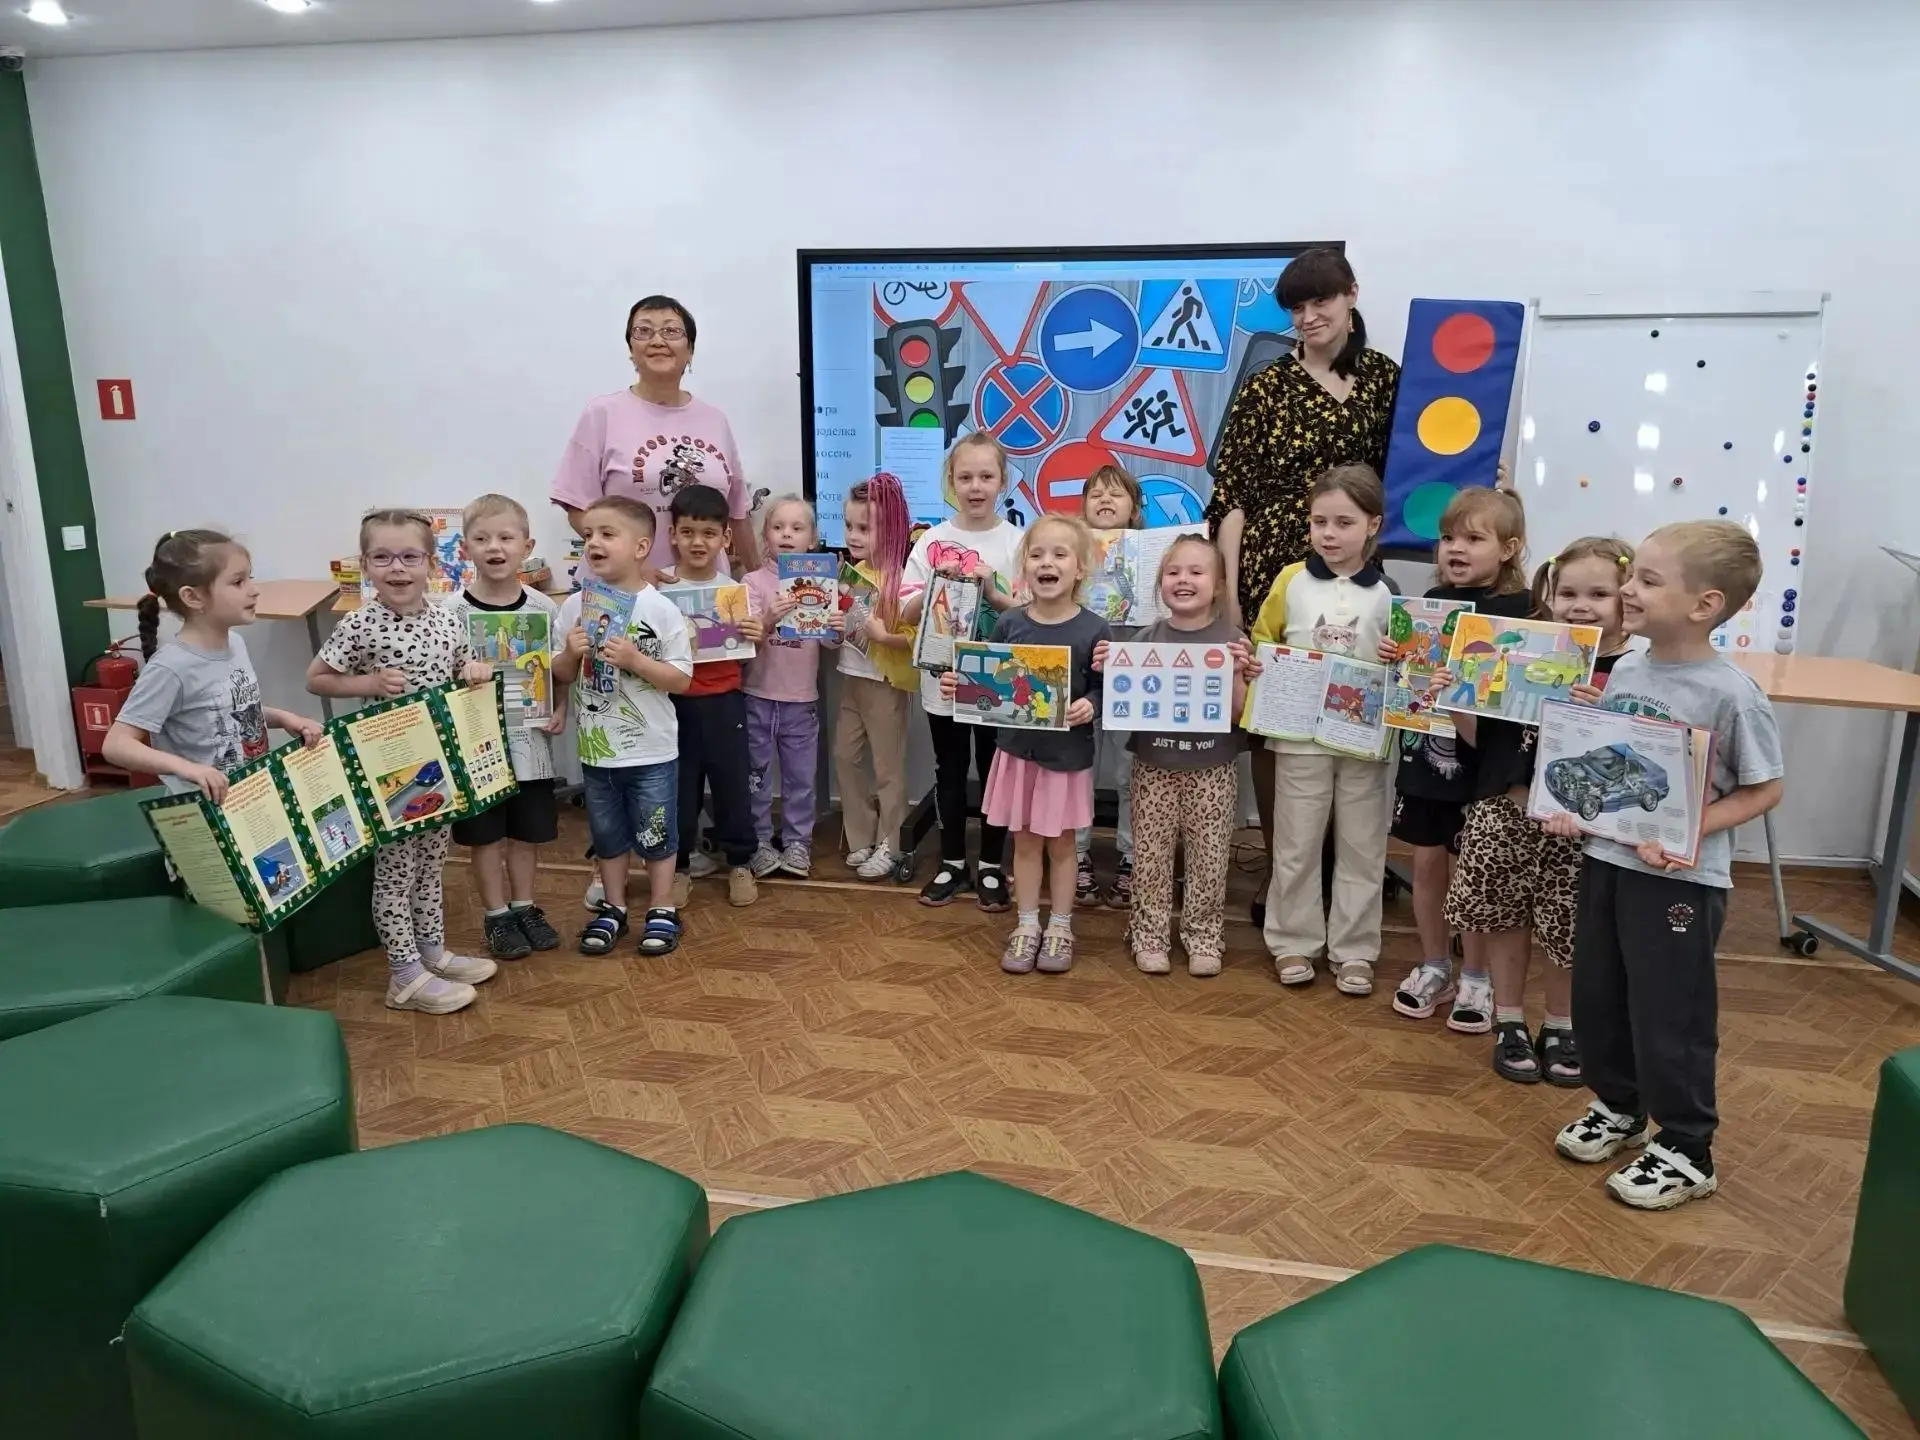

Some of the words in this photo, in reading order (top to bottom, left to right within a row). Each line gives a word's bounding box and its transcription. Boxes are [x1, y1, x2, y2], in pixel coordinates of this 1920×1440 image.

[632, 435, 668, 483] MOTOS
[1207, 704, 1217, 718] P
[1152, 737, 1176, 749] JUST
[1179, 740, 1192, 750] BE
[1196, 739, 1215, 750] YOU
